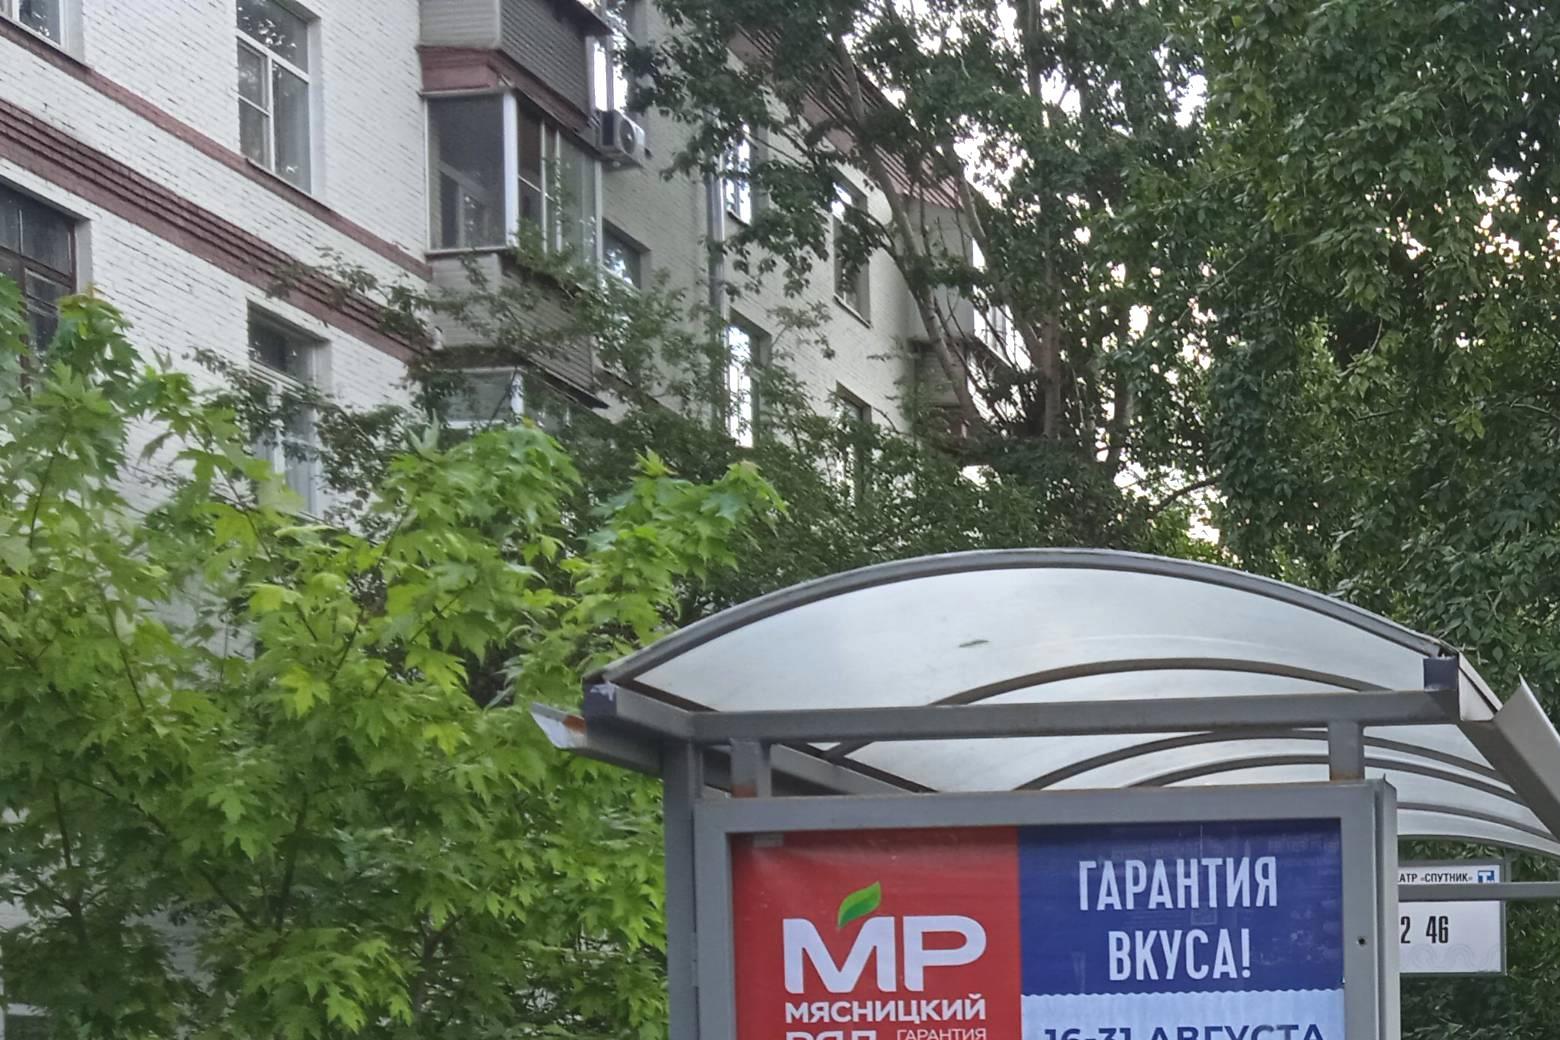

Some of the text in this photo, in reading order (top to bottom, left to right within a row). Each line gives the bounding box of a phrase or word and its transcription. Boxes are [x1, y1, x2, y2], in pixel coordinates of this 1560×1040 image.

[1079, 856, 1278, 912] ГАРАНТИЯ
[782, 914, 987, 994] МР
[1108, 928, 1251, 981] ВКУСА!
[1400, 915, 1449, 944] 2 46
[785, 993, 986, 1025] МЯСНИЦКИЙ
